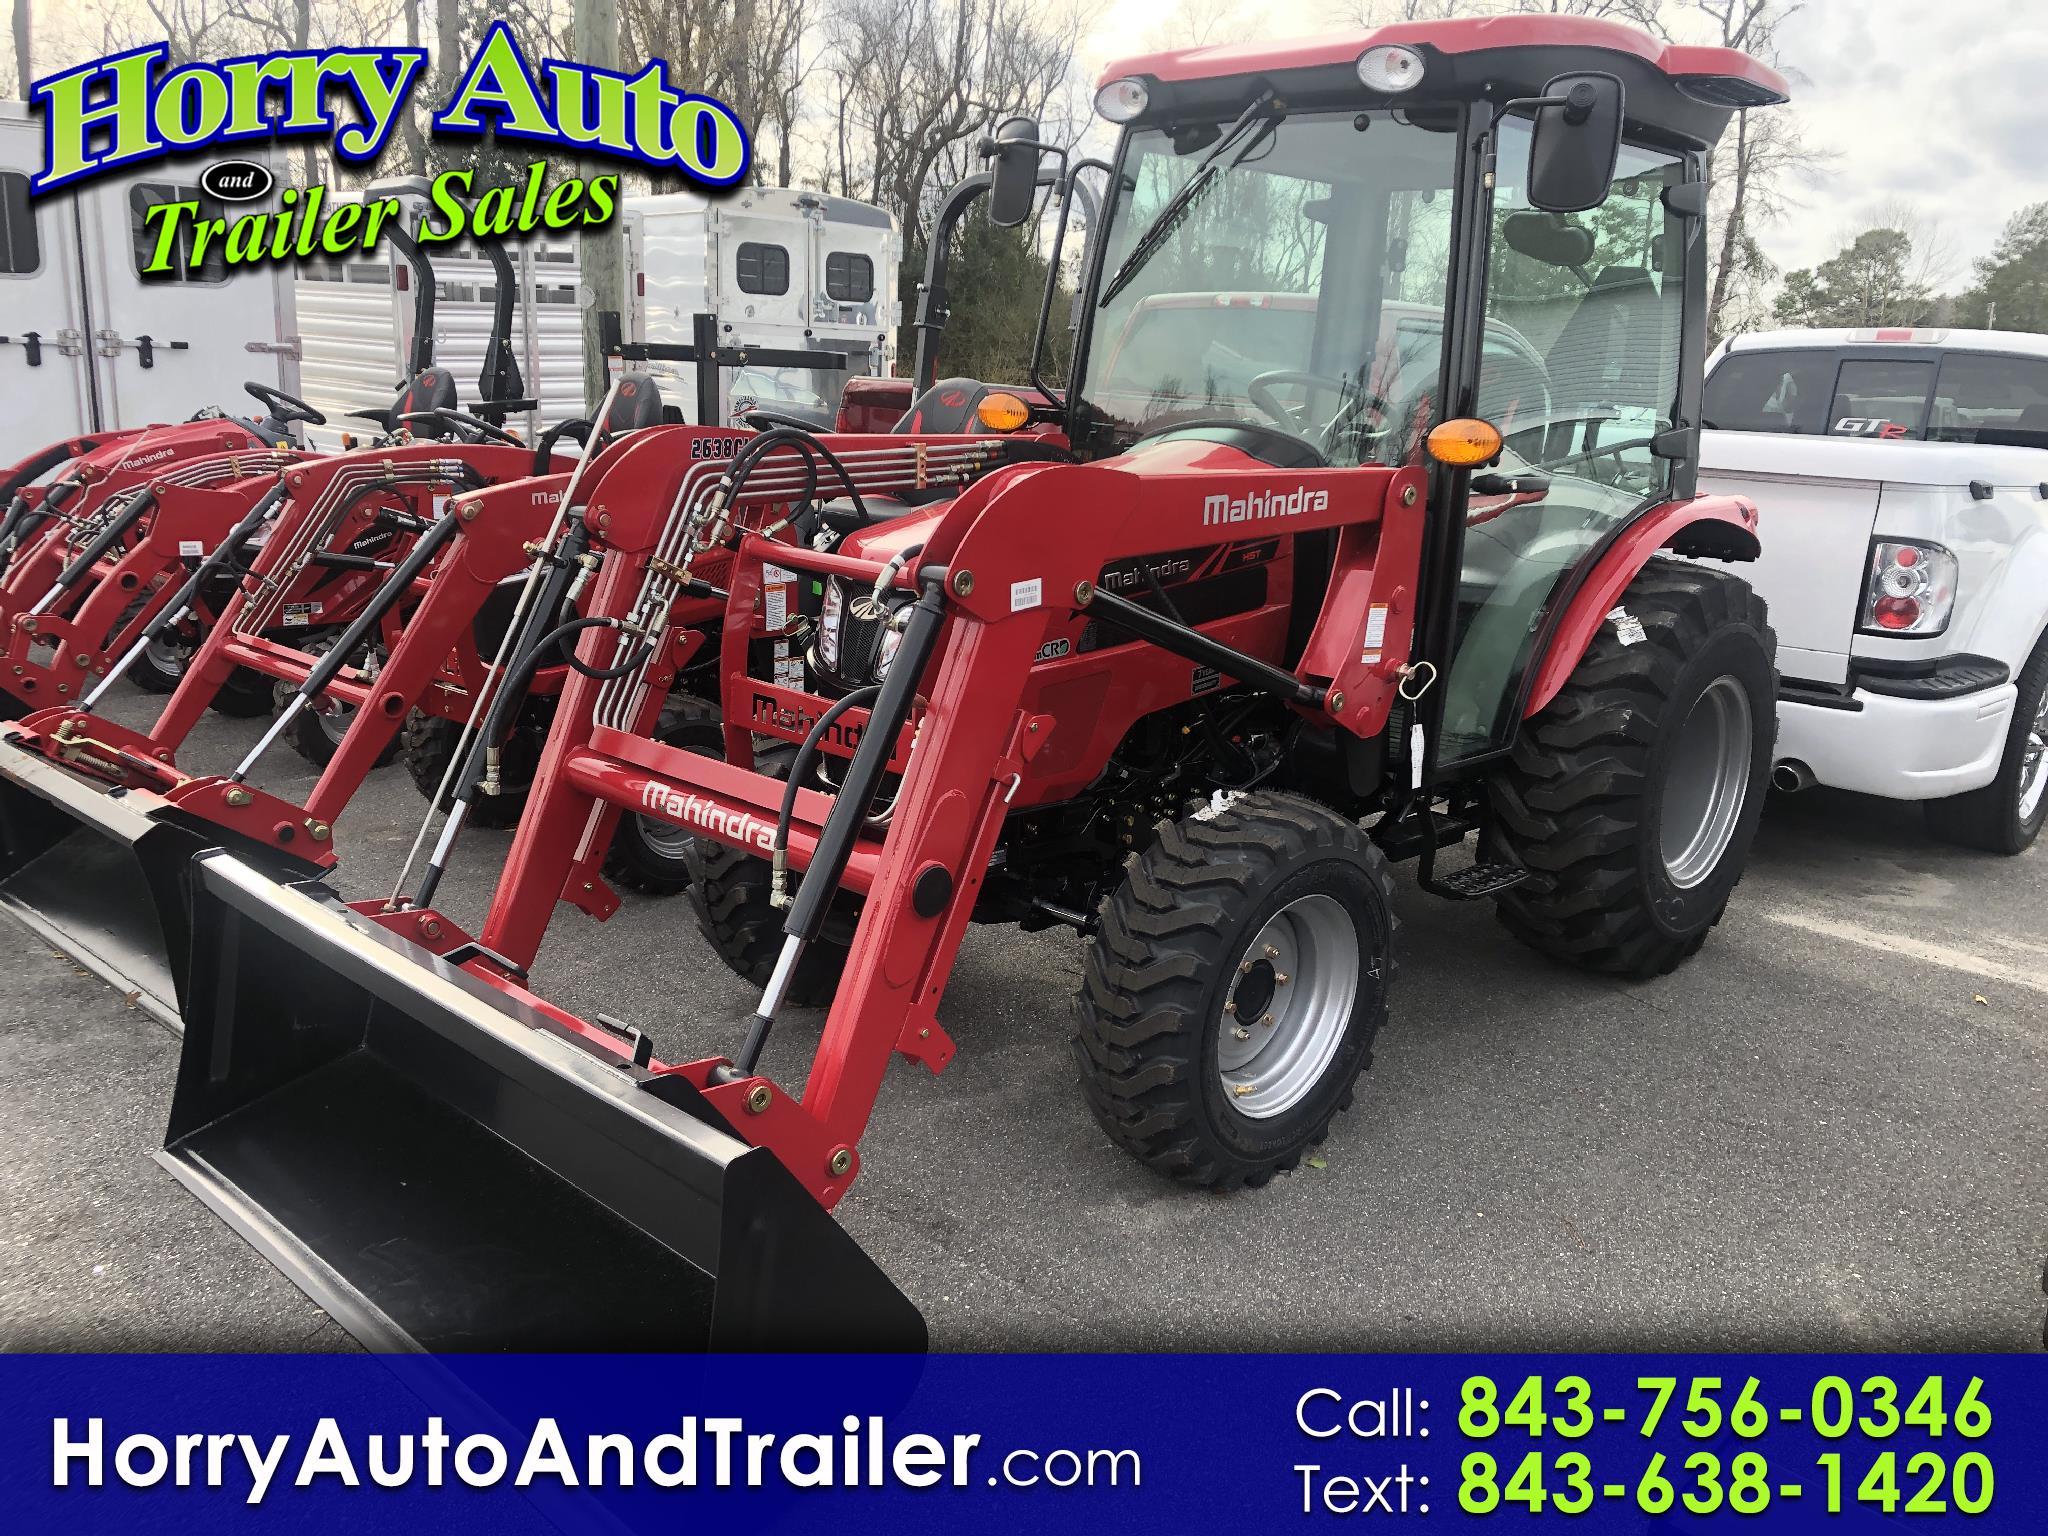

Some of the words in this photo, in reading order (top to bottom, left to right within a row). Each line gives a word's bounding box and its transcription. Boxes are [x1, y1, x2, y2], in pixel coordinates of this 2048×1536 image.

[121, 448, 175, 470] Mahindra
[1203, 485, 1328, 526] Mahindra
[353, 531, 393, 550] Mahindra
[1104, 559, 1190, 590] Mahndra
[642, 779, 778, 852] Mahindra
